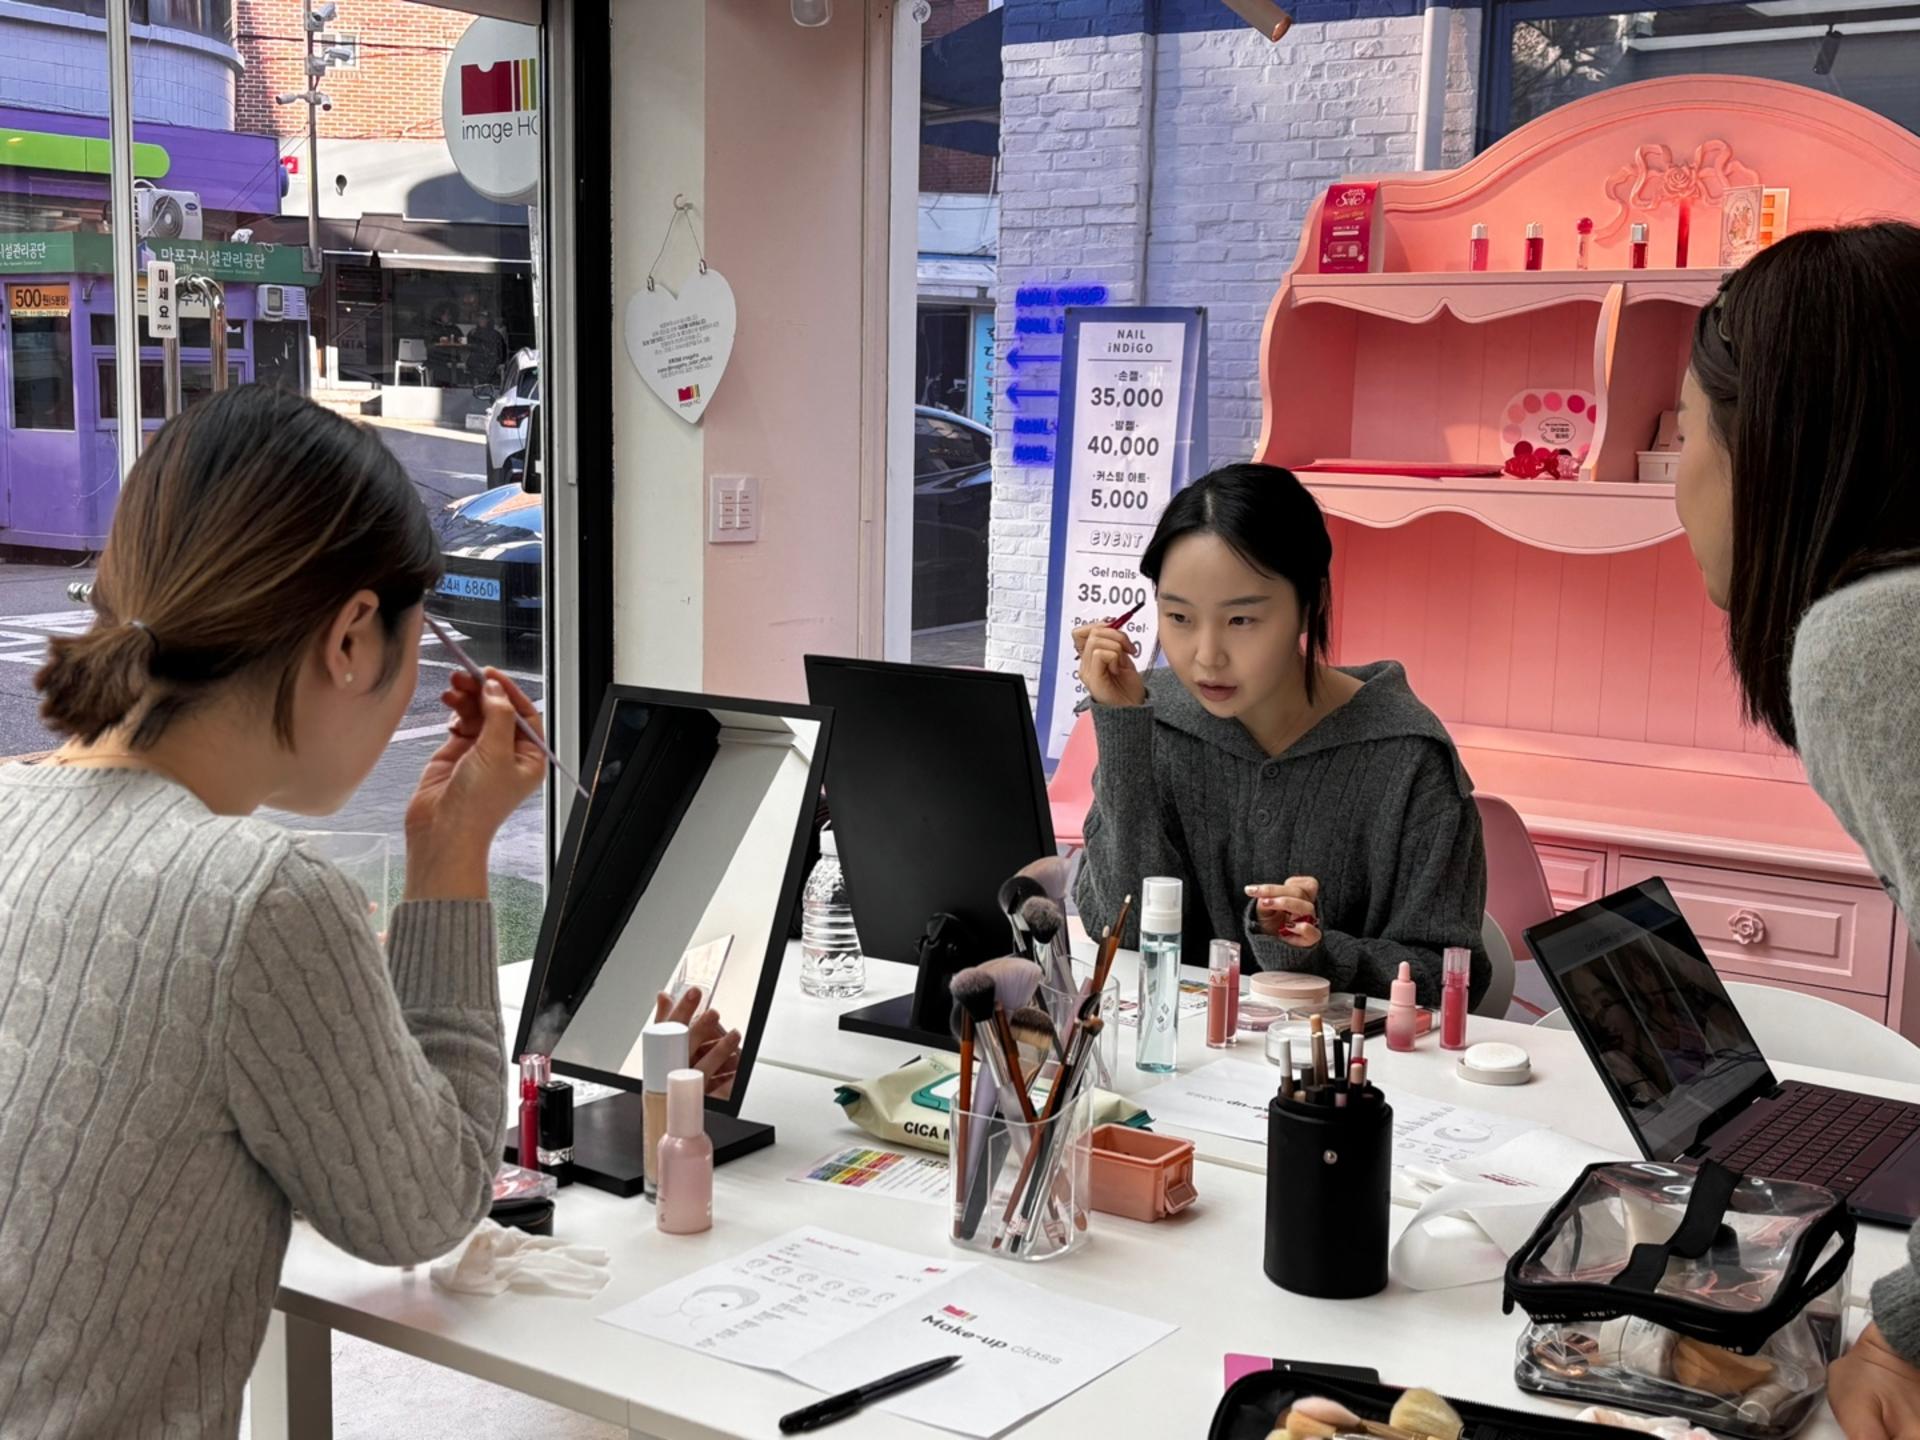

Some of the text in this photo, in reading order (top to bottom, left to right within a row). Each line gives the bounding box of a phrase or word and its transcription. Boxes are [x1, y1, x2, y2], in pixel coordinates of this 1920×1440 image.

[462, 120, 513, 144] image
[161, 247, 265, 269] 마포구시설관리공단
[158, 268, 169, 318] 미세요
[1117, 329, 1146, 340] NAIL
[1090, 387, 1163, 408] 35,000
[1087, 436, 1159, 456] 40,000
[1091, 489, 1148, 510] 5,000
[1090, 530, 1145, 548] EVENT
[1091, 566, 1109, 577] Gel
[465, 581, 494, 597] 6860
[1077, 583, 1146, 605] 35,000
[1127, 622, 1146, 633] Gel
[903, 1121, 939, 1139] CICA
[921, 1314, 1063, 1365] Make-up class
